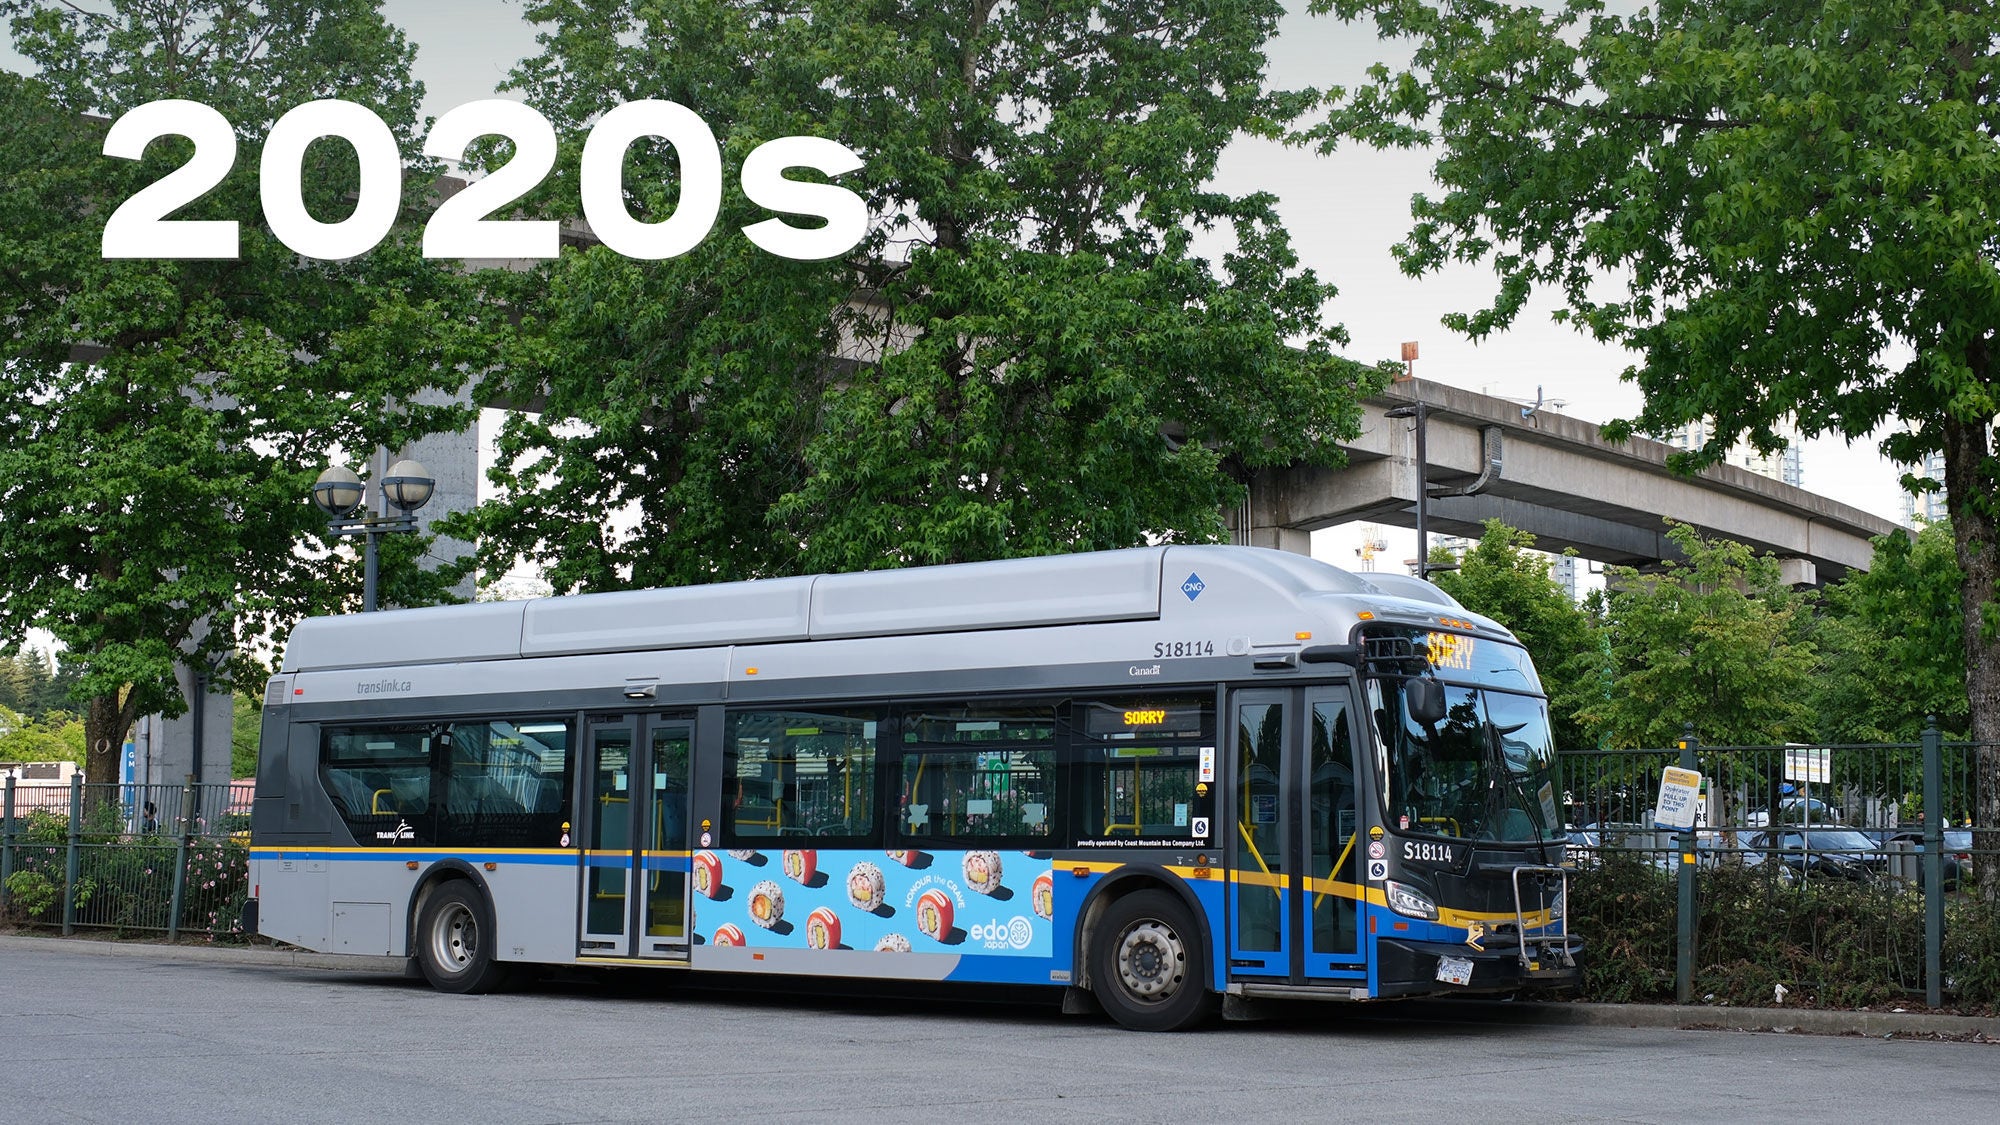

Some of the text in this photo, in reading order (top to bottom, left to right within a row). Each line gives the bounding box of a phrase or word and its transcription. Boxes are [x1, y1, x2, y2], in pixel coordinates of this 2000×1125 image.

[1183, 582, 1202, 592] CNG
[1153, 640, 1214, 658] S18114
[1426, 631, 1474, 670] SORRY
[1129, 665, 1160, 676] Canada
[357, 679, 411, 694] translink.ca
[1124, 710, 1165, 725] SORRY
[1664, 793, 1677, 801] PULL
[1665, 785, 1690, 795] Operator
[1661, 805, 1679, 813] POINT
[1077, 839, 1095, 847] proudly
[1404, 841, 1452, 863] S18114
[905, 874, 966, 909] HONOUR the CRAVE
[970, 918, 1009, 941] edo
